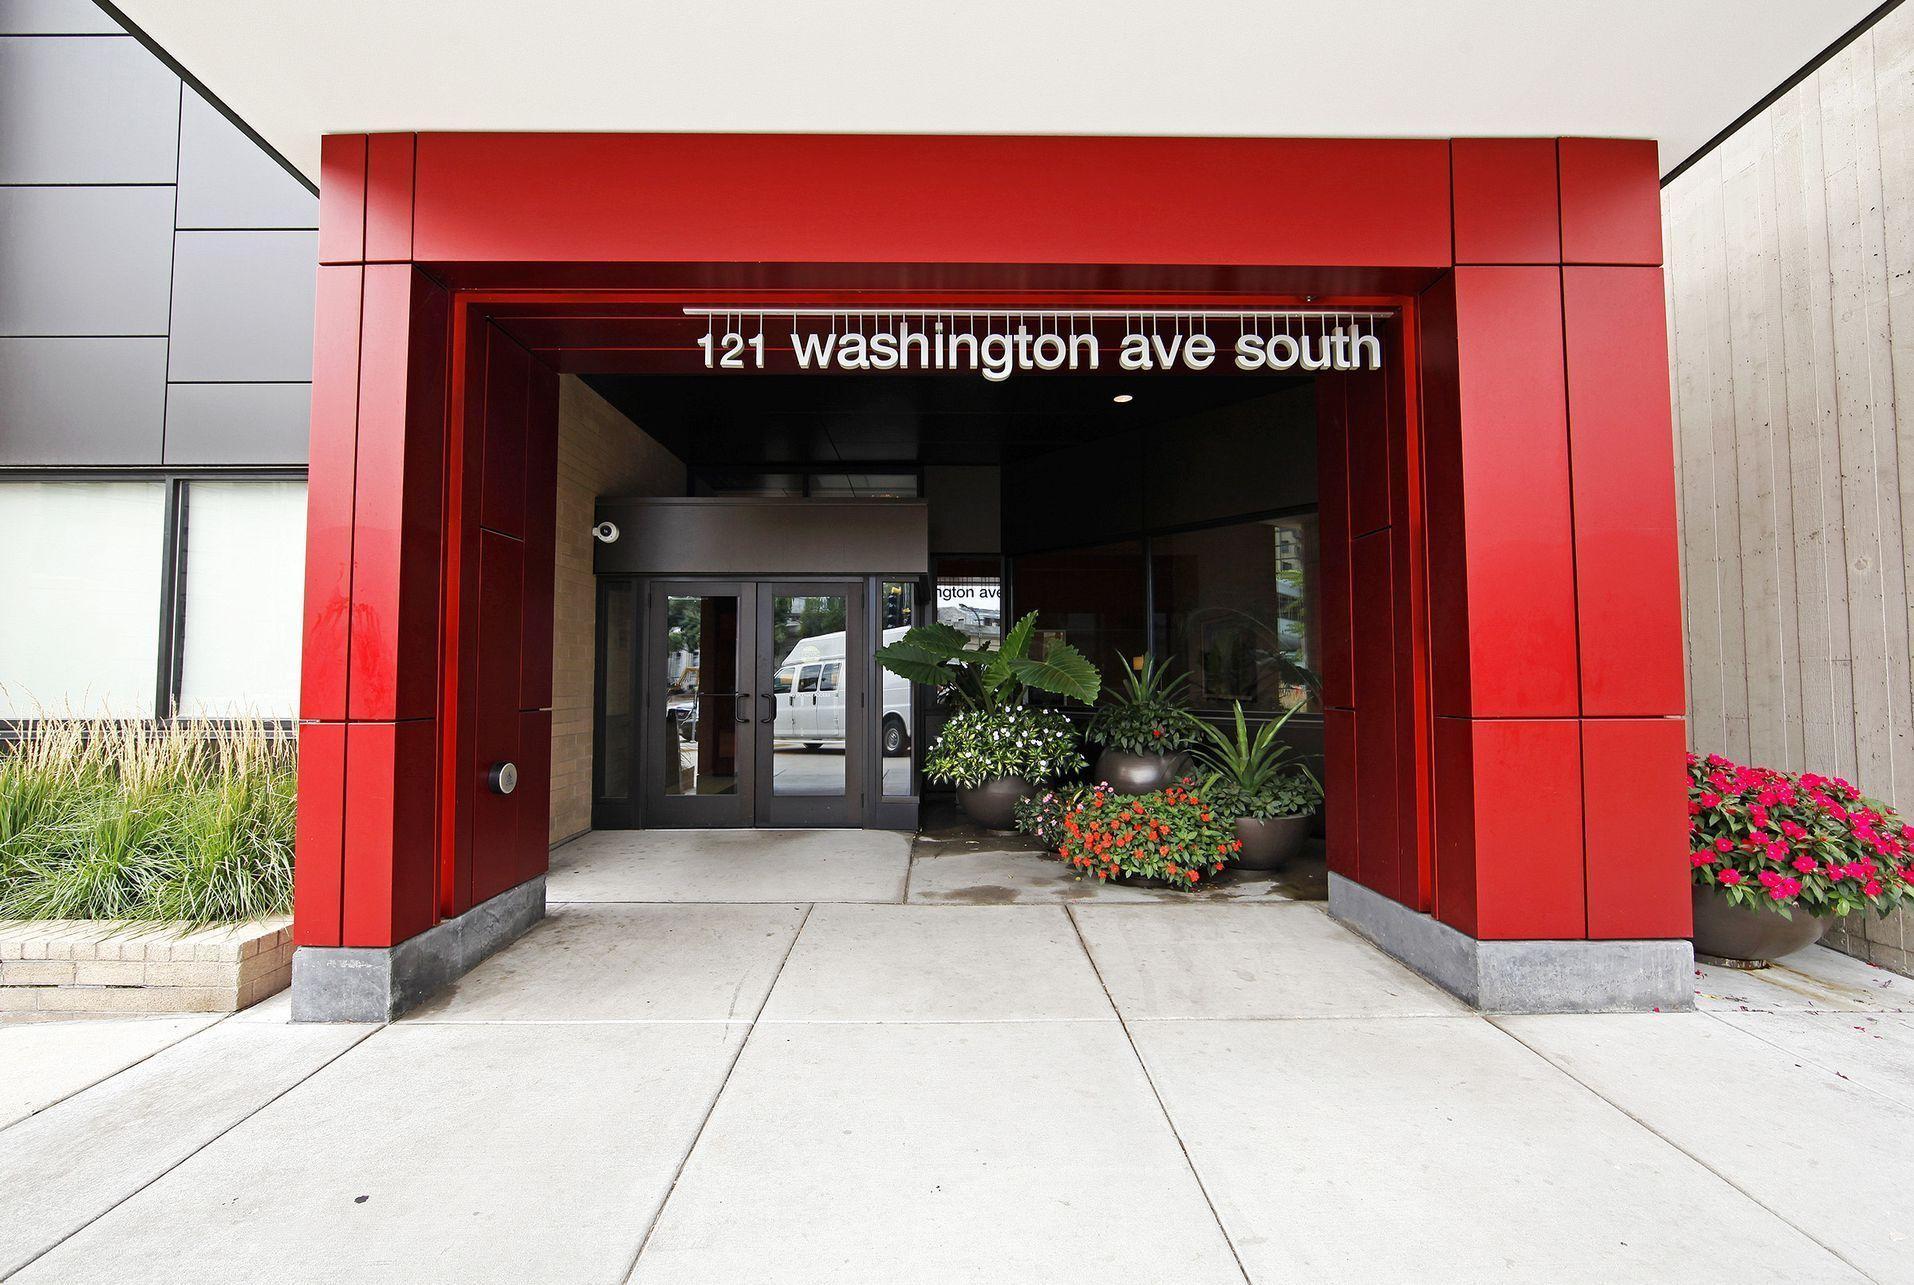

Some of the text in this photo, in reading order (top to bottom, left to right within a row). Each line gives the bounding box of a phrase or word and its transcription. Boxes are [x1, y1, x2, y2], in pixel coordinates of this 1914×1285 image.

[697, 321, 1381, 382] 121 washington ave south
